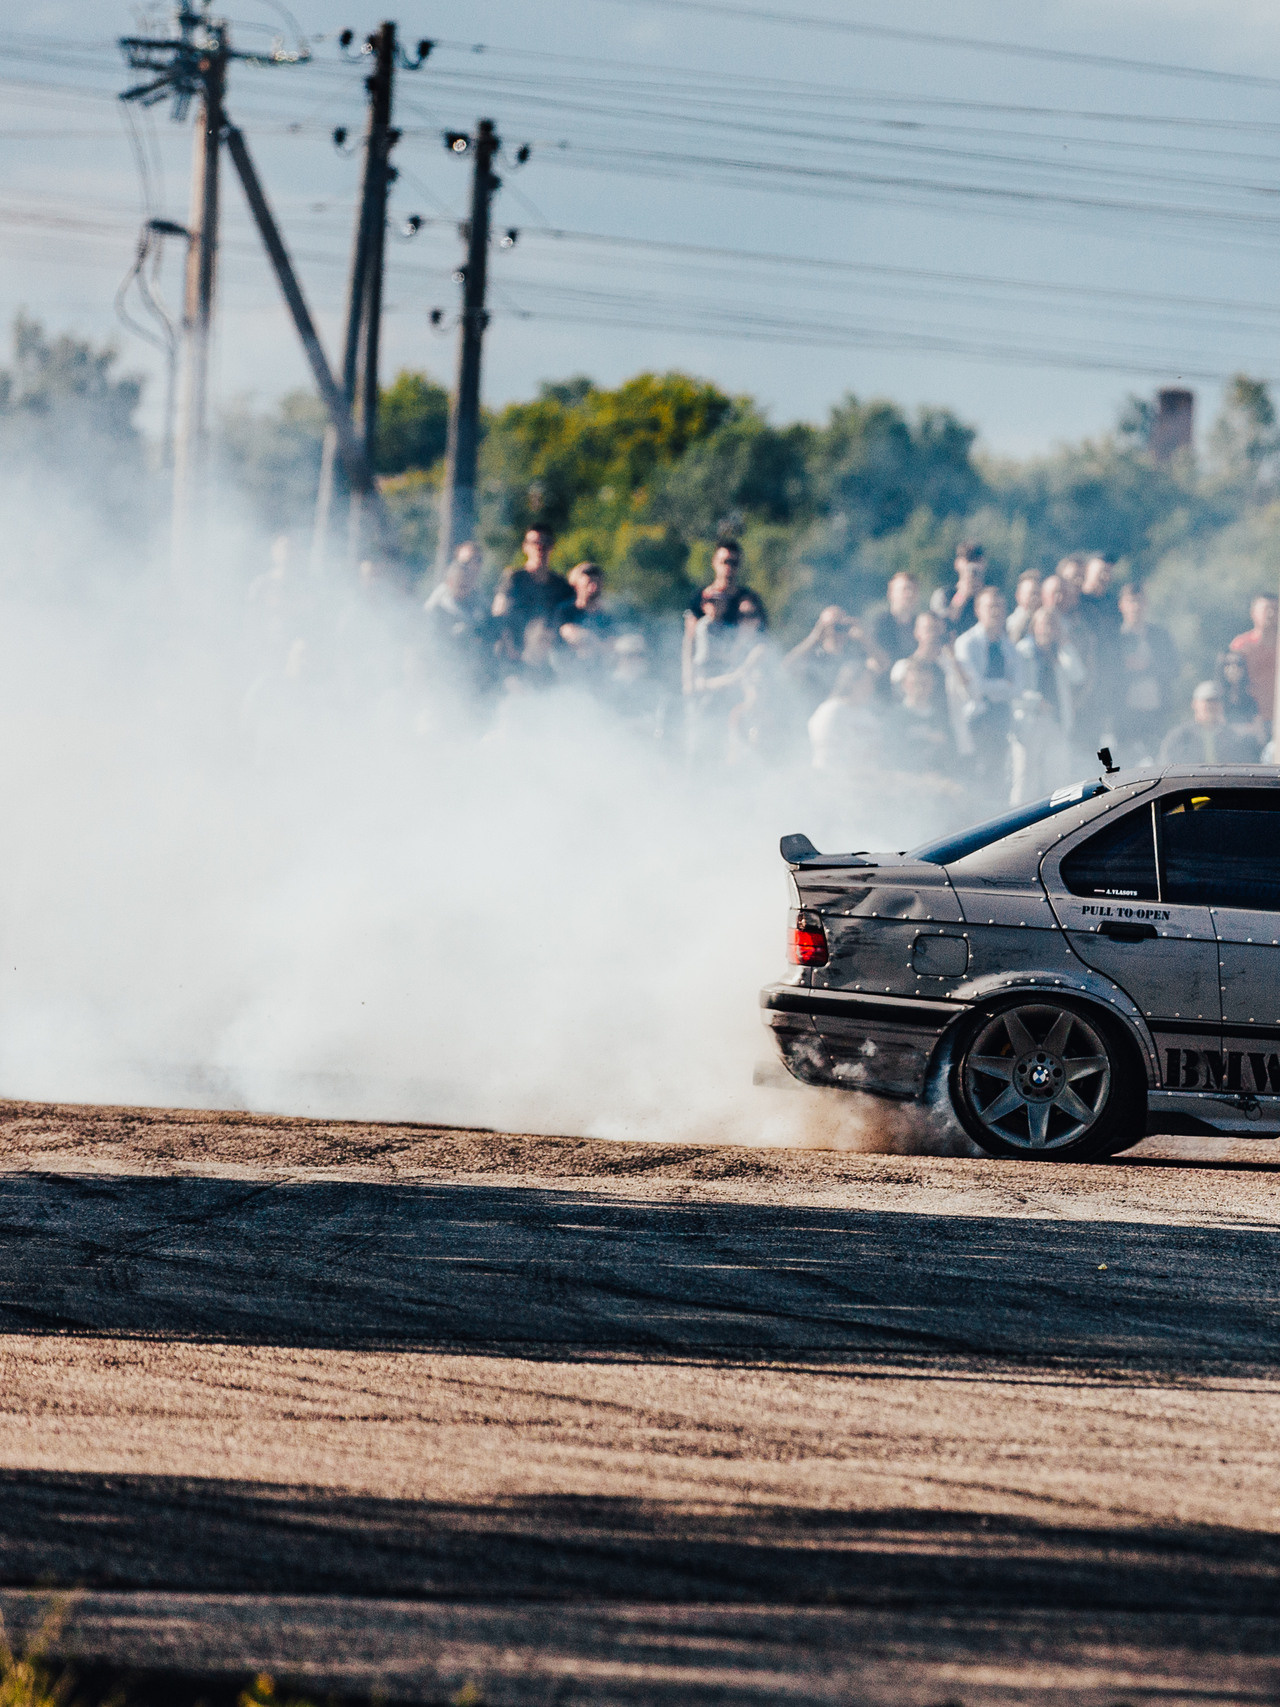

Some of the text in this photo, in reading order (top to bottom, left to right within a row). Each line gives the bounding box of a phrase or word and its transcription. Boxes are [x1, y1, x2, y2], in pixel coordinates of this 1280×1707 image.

[1081, 905, 1171, 921] PULL TO OPEN
